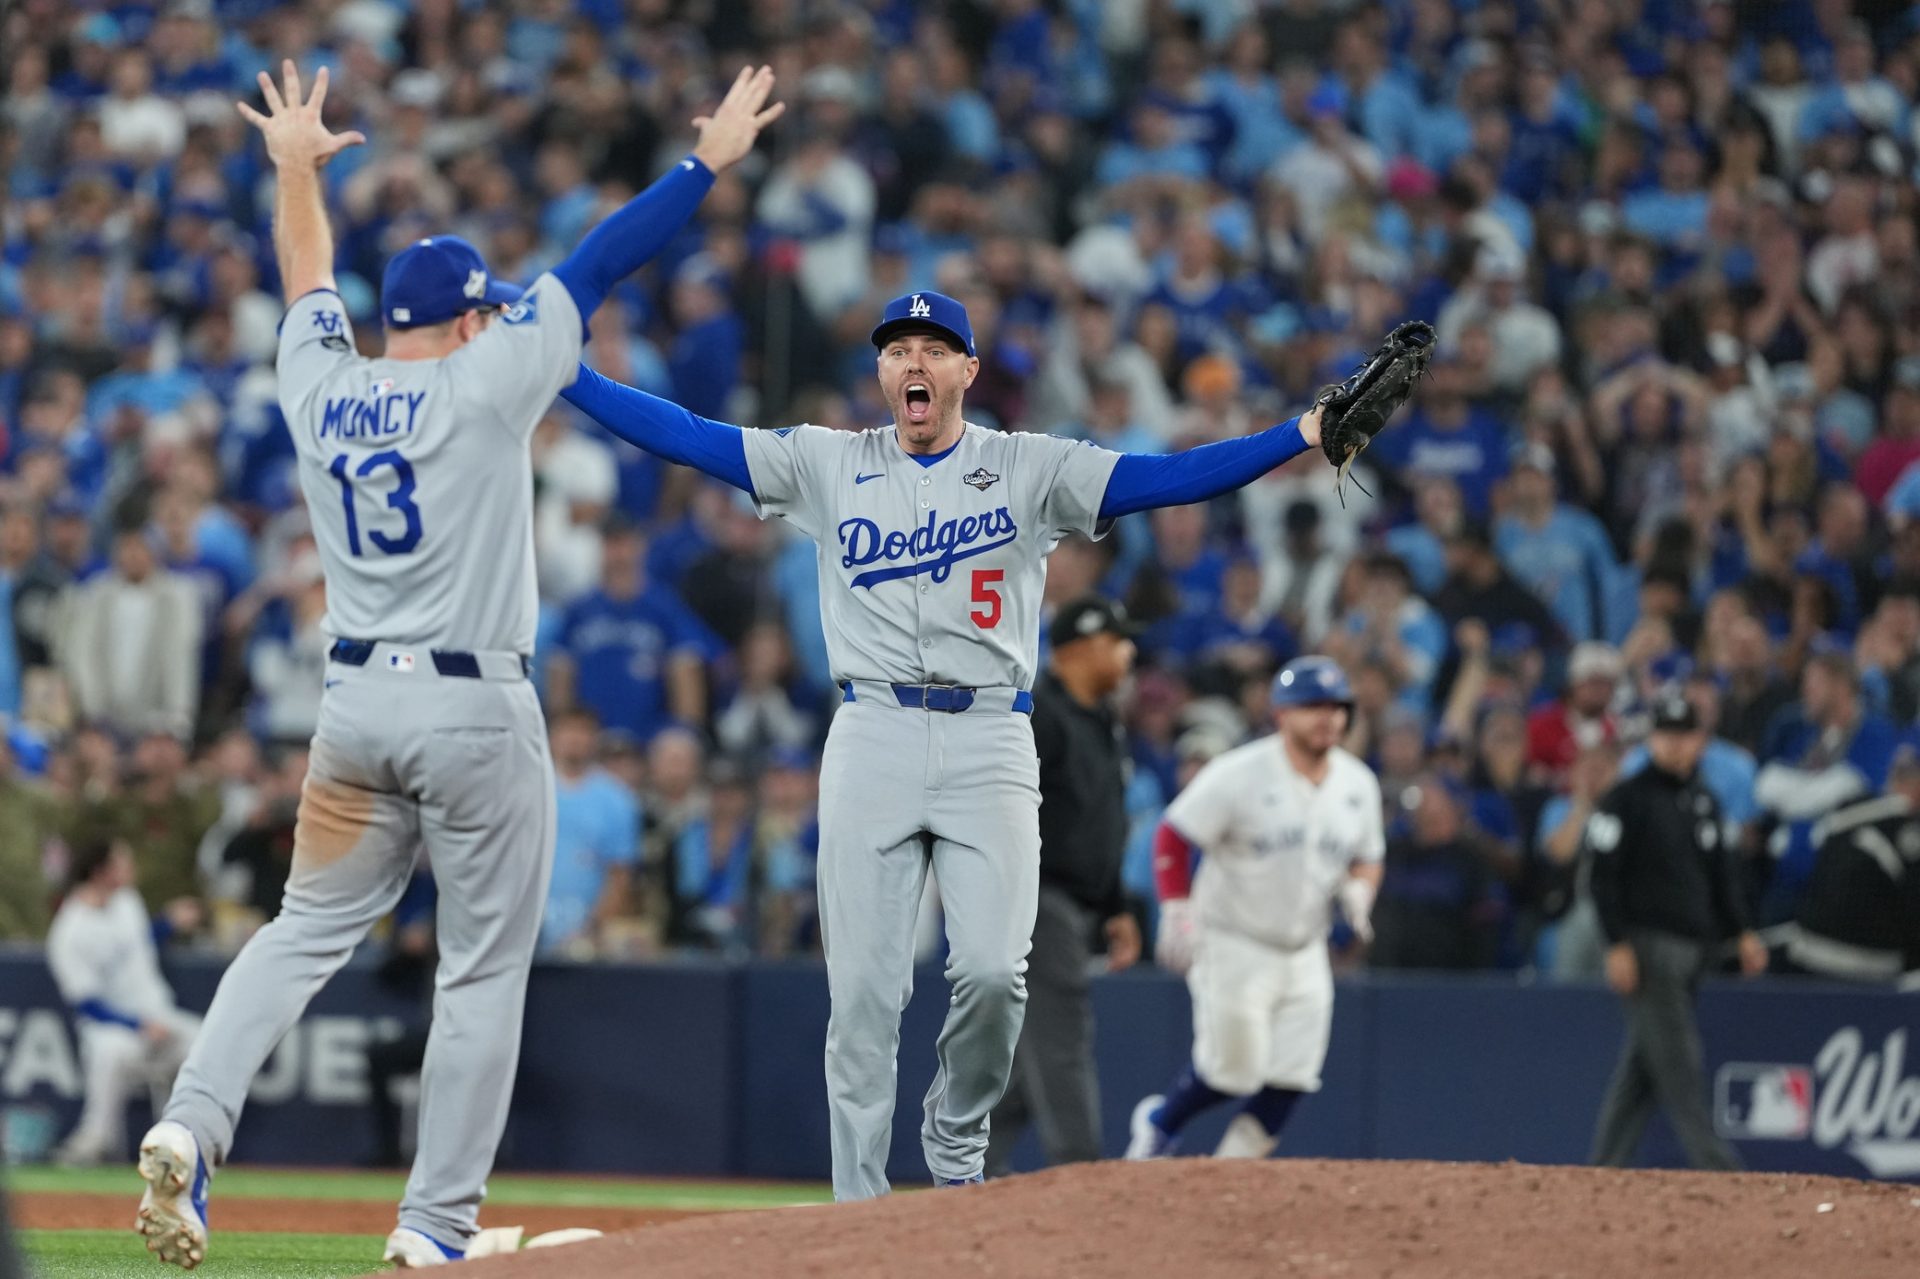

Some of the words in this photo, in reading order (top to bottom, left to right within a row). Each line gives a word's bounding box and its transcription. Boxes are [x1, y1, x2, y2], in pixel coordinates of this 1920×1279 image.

[909, 294, 931, 317] LA
[319, 390, 427, 438] MUNCY
[329, 449, 423, 557] 13
[838, 506, 1017, 584] Dodgers
[970, 569, 1004, 629] 5
